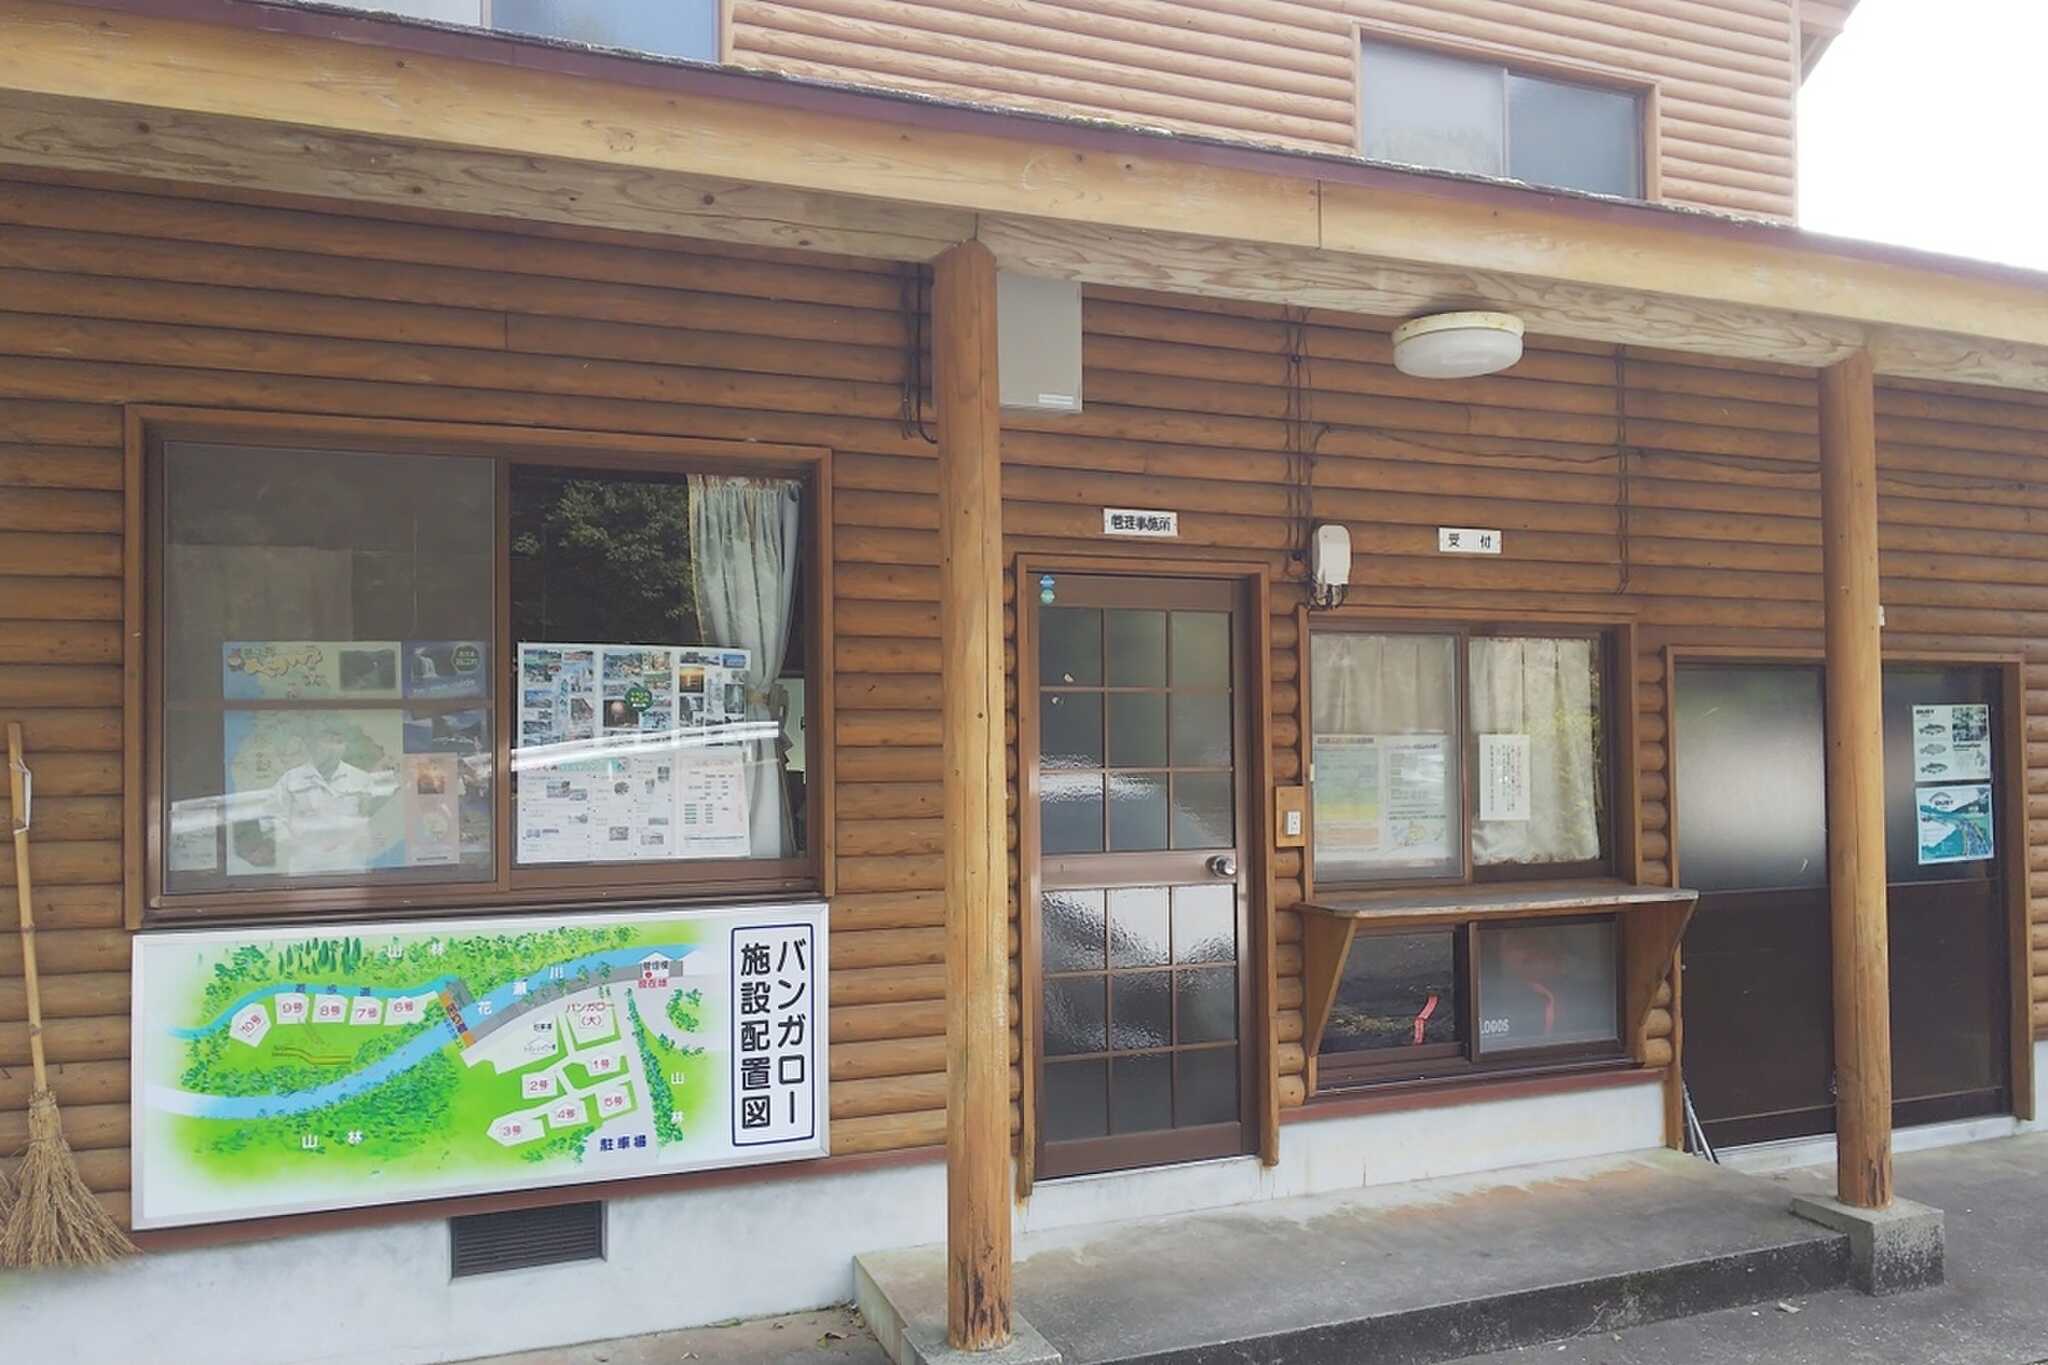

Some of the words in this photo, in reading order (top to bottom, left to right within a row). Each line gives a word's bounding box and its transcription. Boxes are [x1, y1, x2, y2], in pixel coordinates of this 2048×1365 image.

[1448, 532, 1492, 549] 受付
[740, 942, 772, 1130] 施設配置図
[776, 937, 808, 1125] バンガロー
